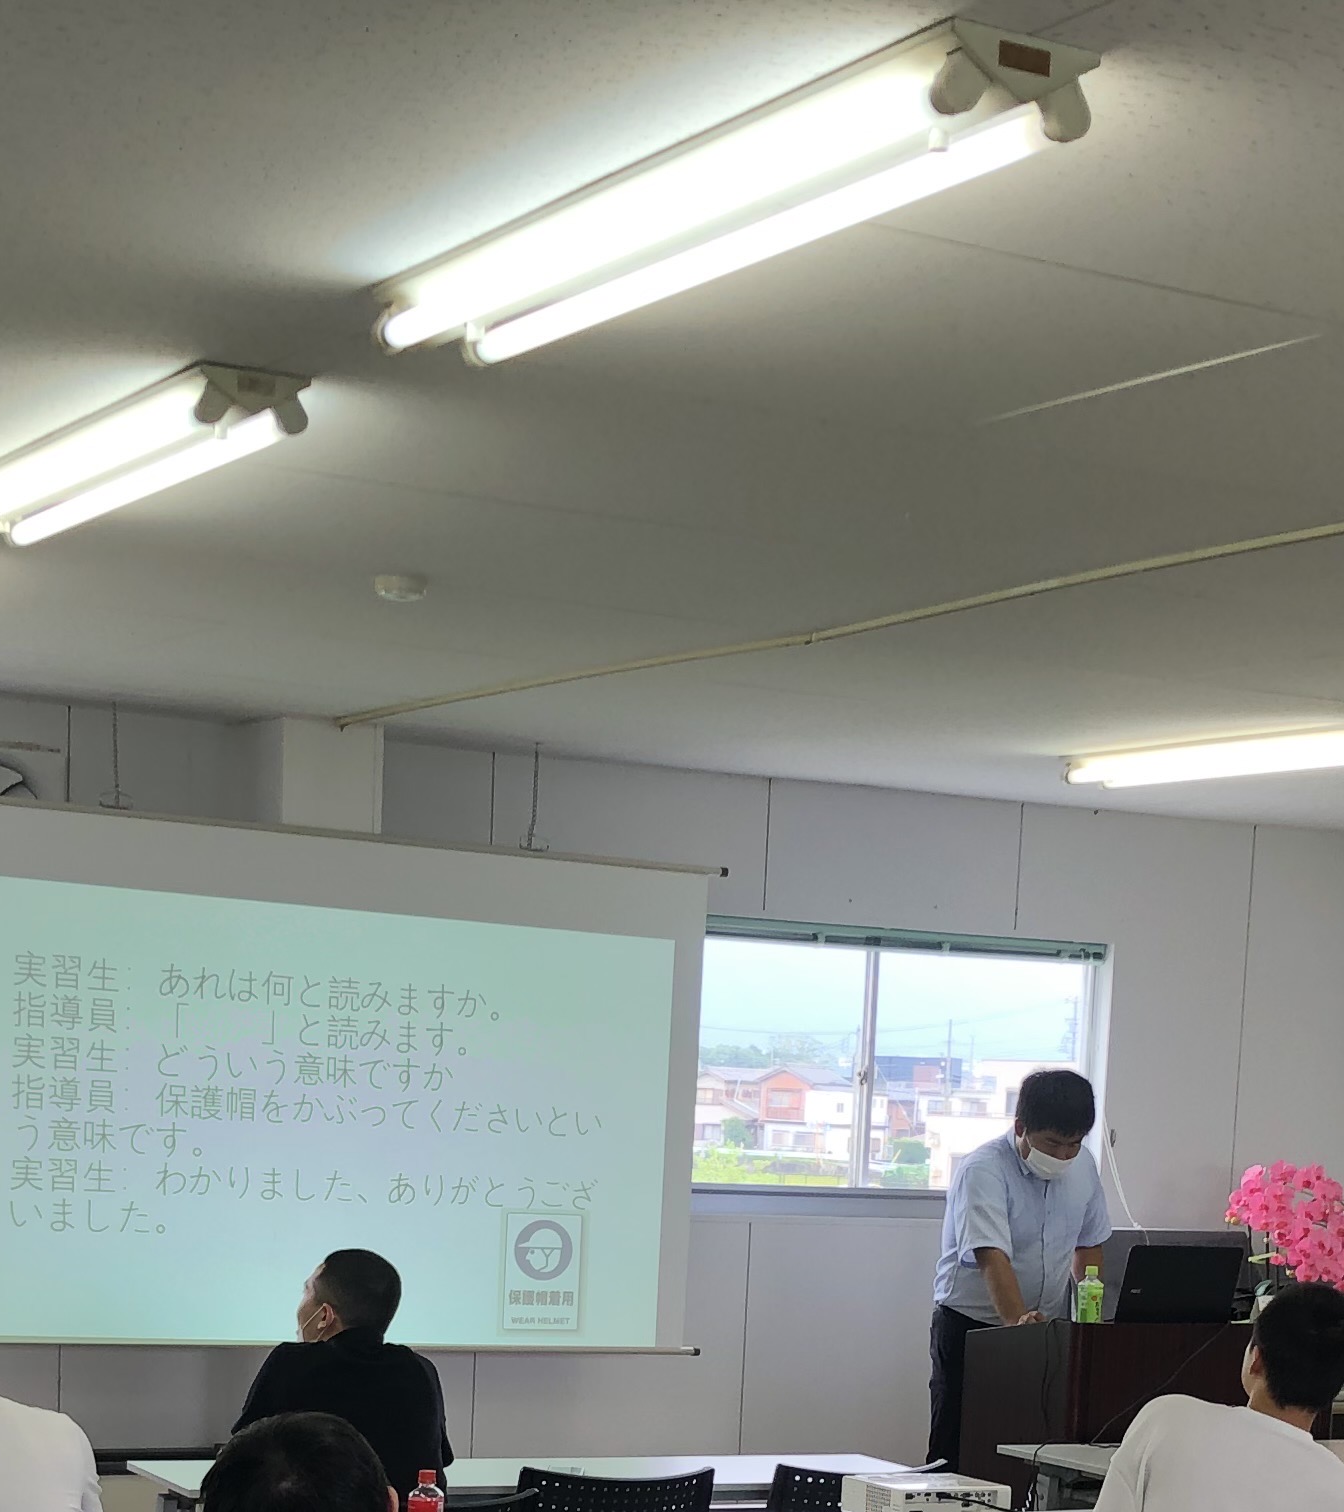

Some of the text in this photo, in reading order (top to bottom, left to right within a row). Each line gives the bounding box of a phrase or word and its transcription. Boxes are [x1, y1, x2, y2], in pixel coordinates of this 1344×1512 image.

[17, 1115, 203, 1158] う意味です。
[9, 1198, 166, 1234] いました。
[511, 1316, 571, 1325] WEAR HELMET
